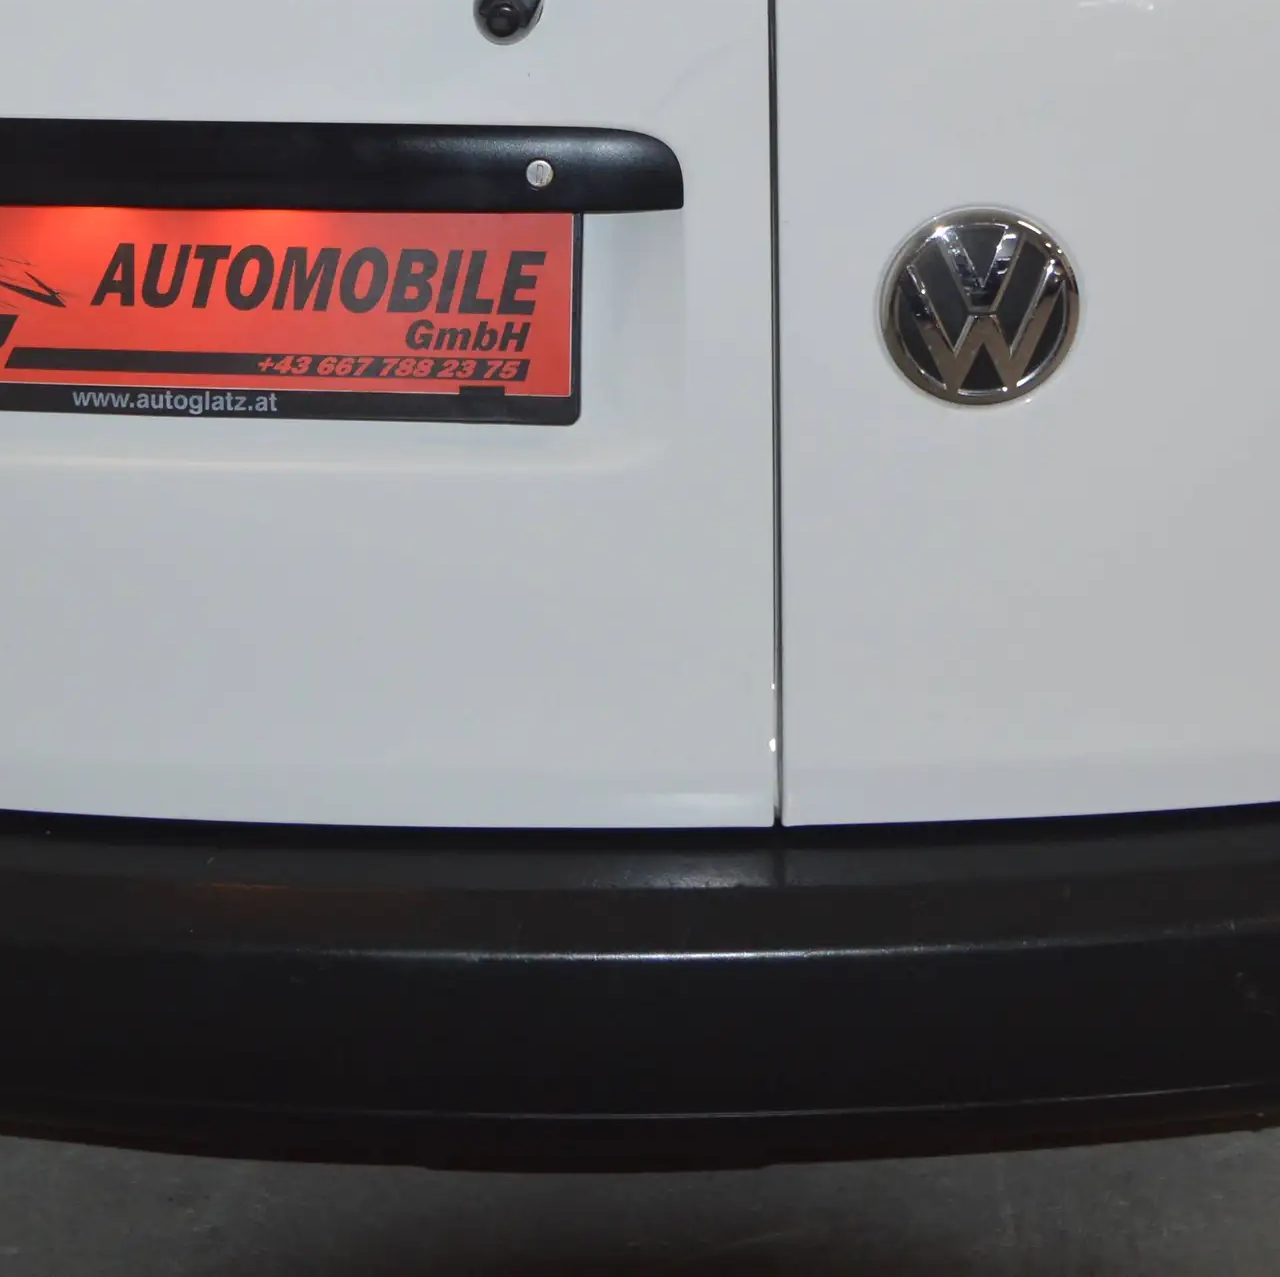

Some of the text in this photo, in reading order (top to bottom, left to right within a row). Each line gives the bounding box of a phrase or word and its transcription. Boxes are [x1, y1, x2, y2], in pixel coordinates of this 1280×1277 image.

[90, 242, 546, 315] AUTOMOBILE
[890, 212, 1074, 400] VW
[405, 319, 531, 353] GmbH
[257, 355, 521, 380] +43 667 788 23 75
[72, 390, 278, 415] www.autoglatz.at
